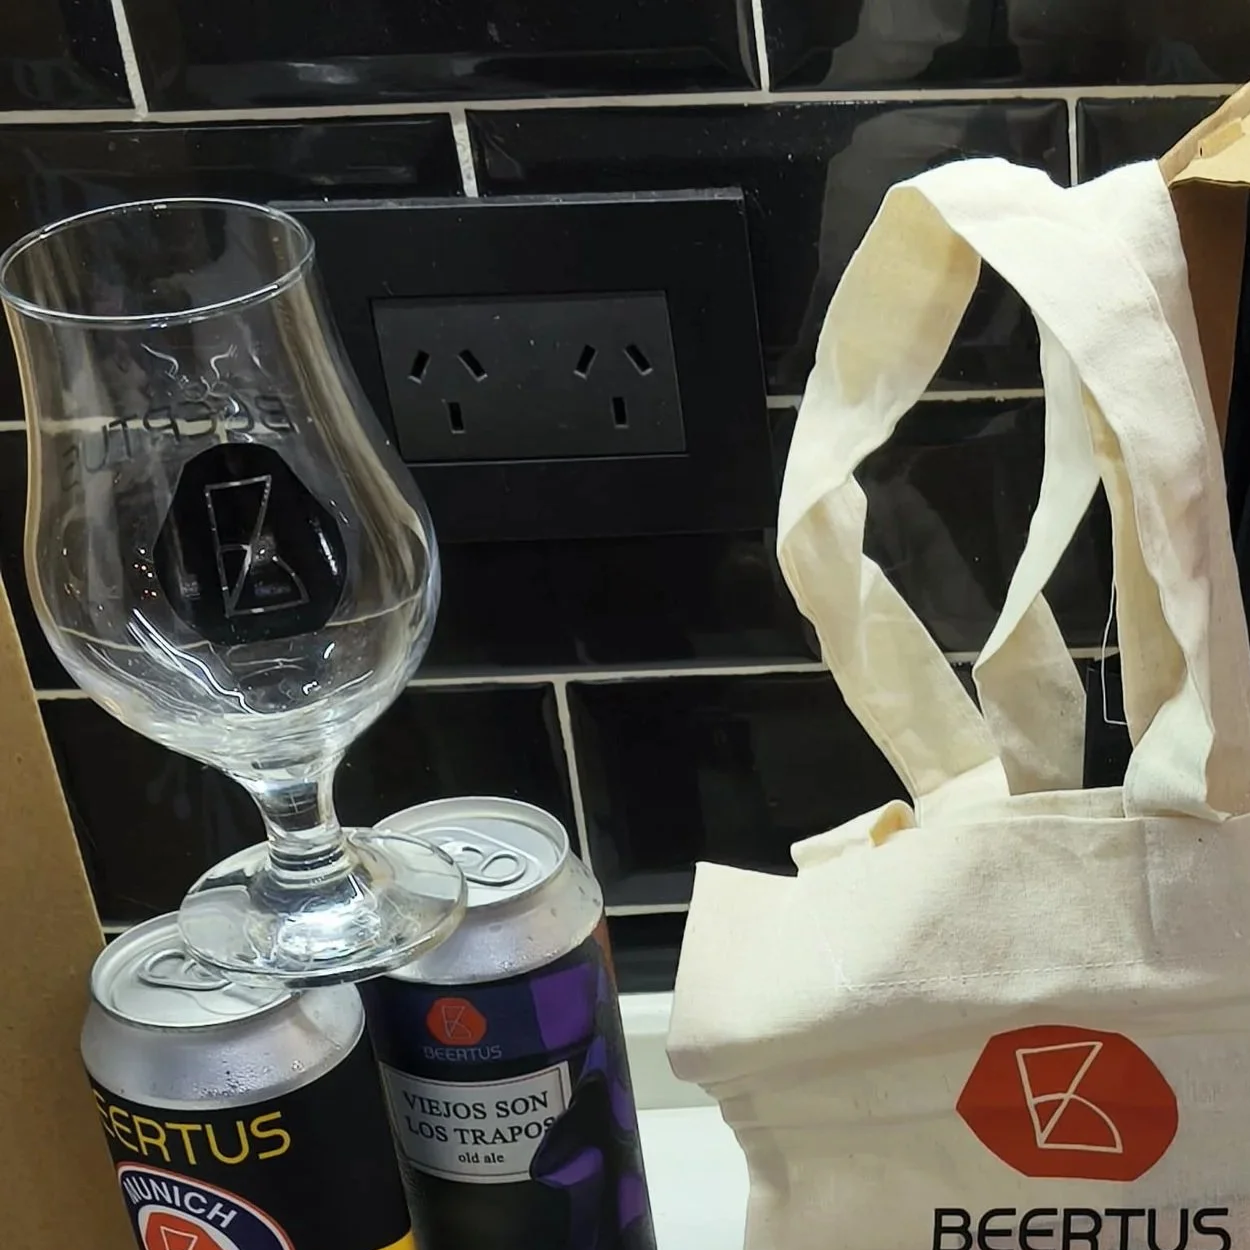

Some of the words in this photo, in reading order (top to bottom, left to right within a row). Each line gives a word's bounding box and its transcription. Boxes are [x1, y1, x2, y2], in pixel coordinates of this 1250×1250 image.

[423, 1044, 502, 1061] BEERTUS
[402, 1091, 487, 1120] VIEJOS
[495, 1091, 548, 1118] SON
[405, 1115, 448, 1142] LOS
[458, 1152, 480, 1164] old
[483, 1152, 505, 1164] ale
[123, 1176, 237, 1228] MUNICH
